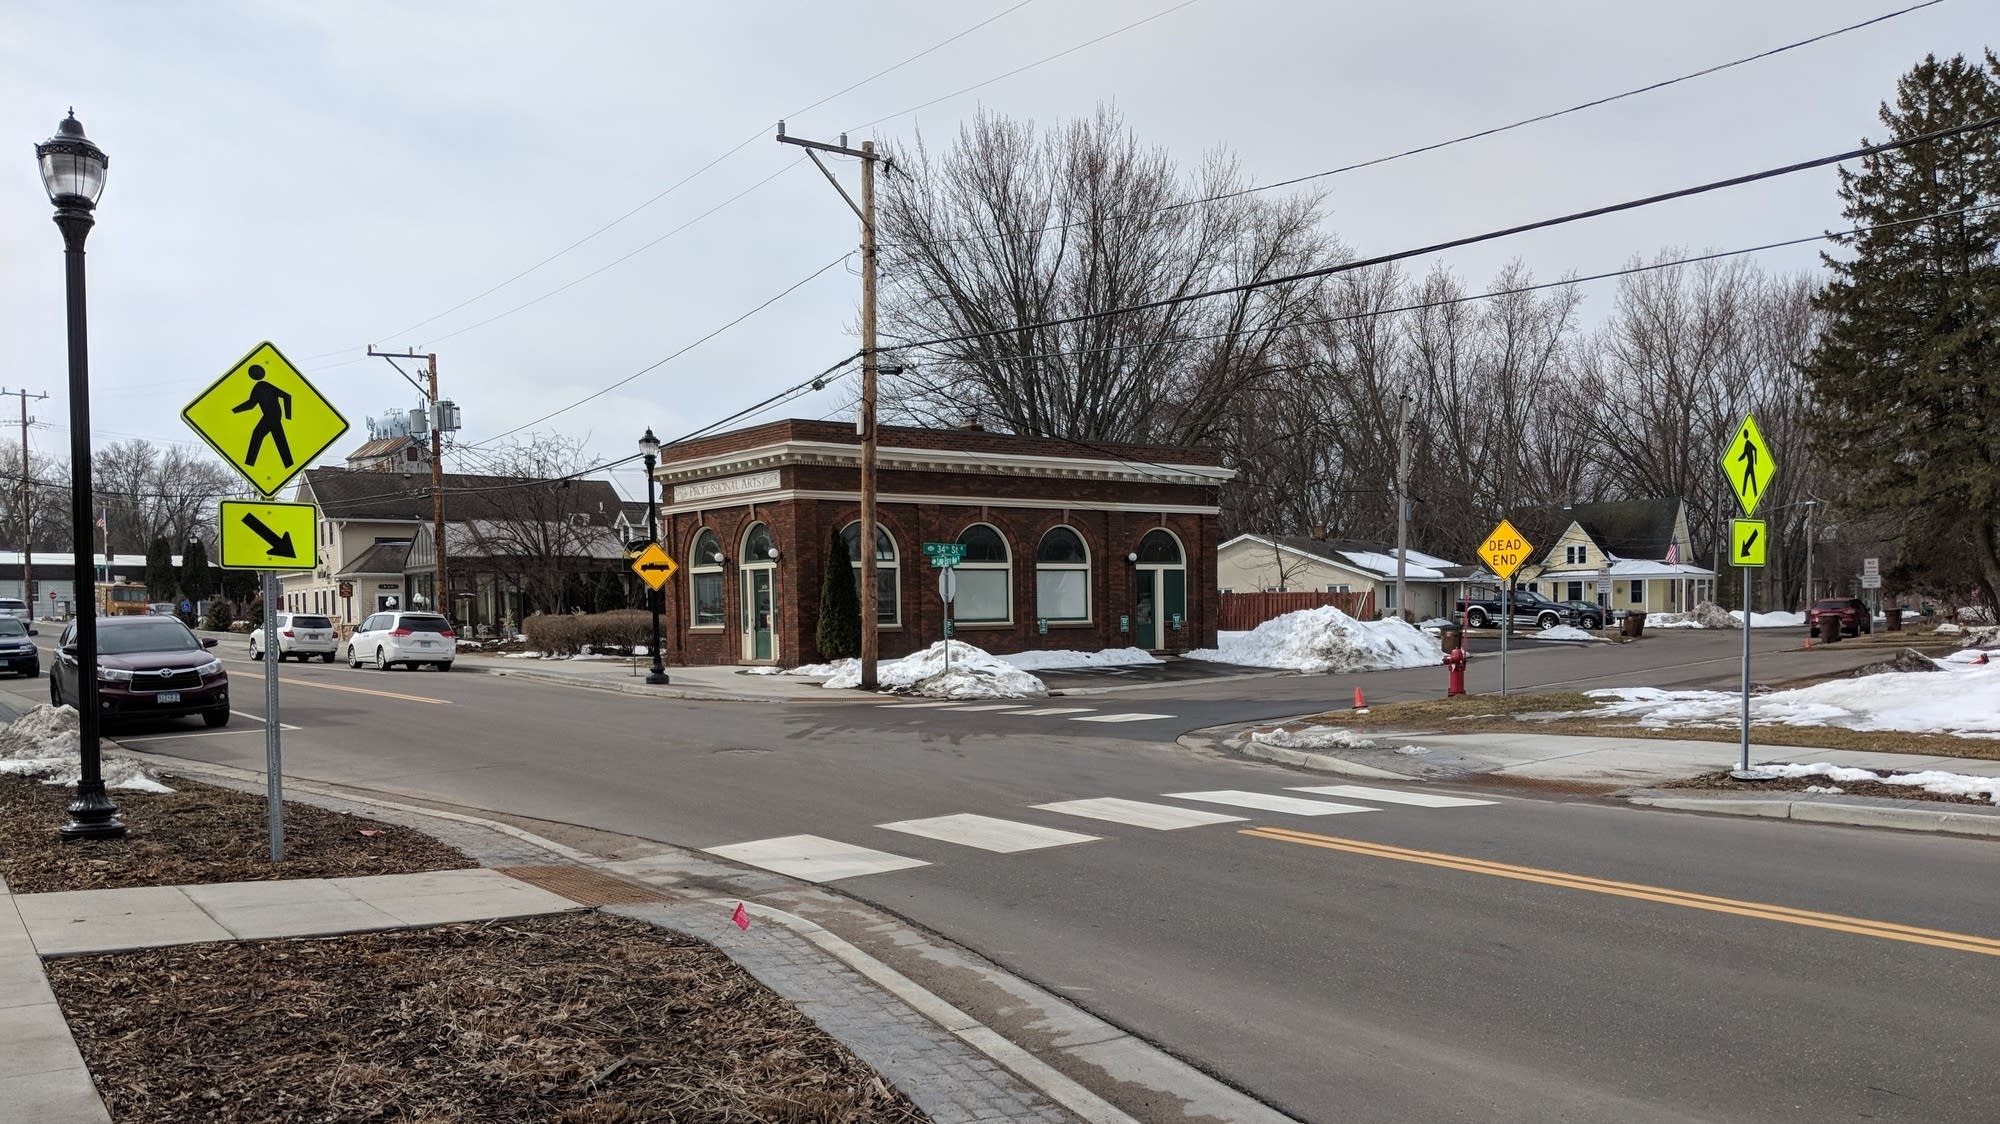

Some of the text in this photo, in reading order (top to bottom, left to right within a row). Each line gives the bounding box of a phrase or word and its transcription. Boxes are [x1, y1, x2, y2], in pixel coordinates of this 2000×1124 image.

[689, 481, 740, 497] PROFESSIONAL
[741, 478, 763, 489] ARTS
[951, 545, 959, 554] St
[1489, 539, 1522, 551] DEAD
[1493, 554, 1517, 565] END
